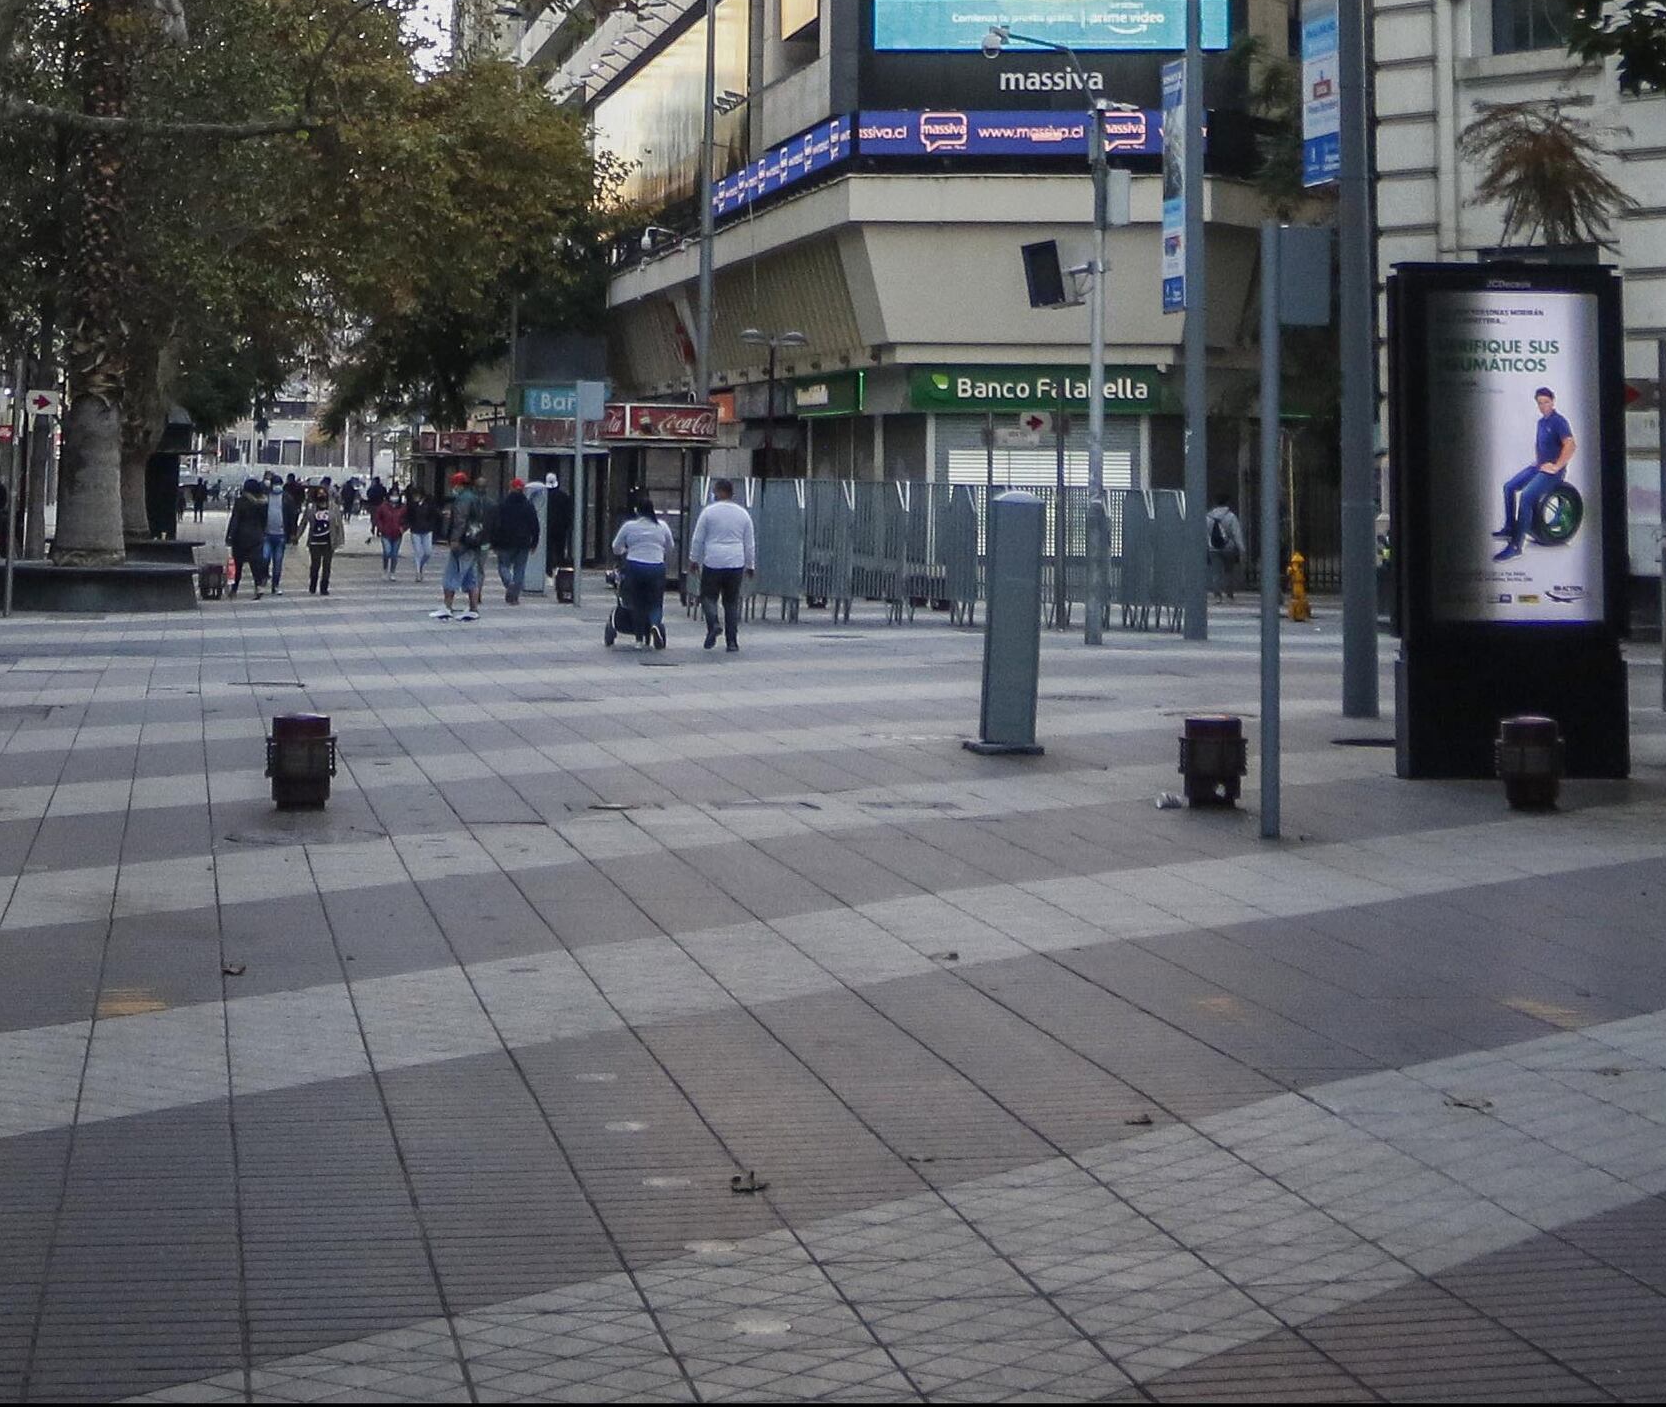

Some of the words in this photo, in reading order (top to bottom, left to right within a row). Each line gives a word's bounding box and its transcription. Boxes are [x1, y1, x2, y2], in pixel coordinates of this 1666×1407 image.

[1090, 11, 1129, 27] prime
[1129, 11, 1165, 24] video
[999, 66, 1104, 92] massiva
[921, 123, 967, 135] massiva
[1528, 340, 1560, 355] SUS
[956, 378, 1030, 399] Banco
[1036, 378, 1149, 399] Flaella
